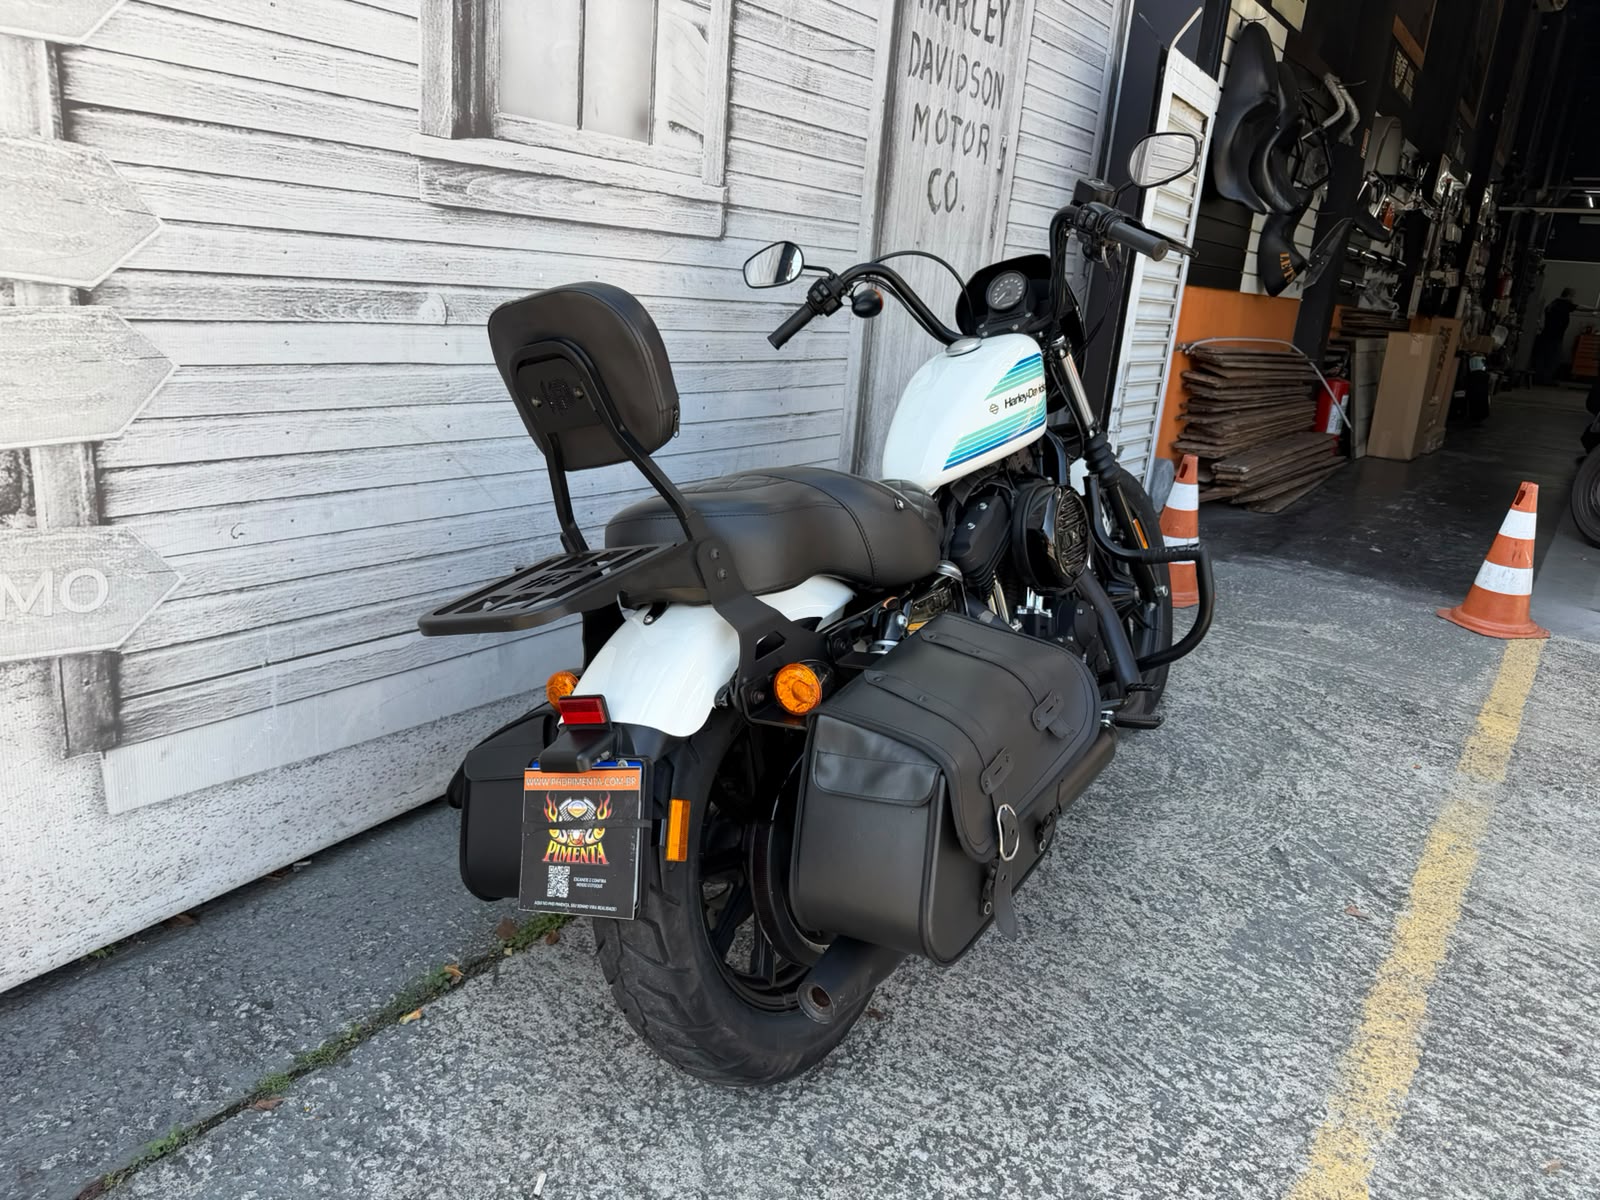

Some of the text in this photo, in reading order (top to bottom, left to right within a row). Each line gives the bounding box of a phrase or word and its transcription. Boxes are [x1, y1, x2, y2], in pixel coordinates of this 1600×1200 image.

[919, 0, 1010, 47] RLEY
[907, 31, 1005, 110] DAVIDSON
[912, 102, 990, 165] MOTOR
[927, 168, 965, 215] CO.
[542, 840, 610, 865] PIMENTA
